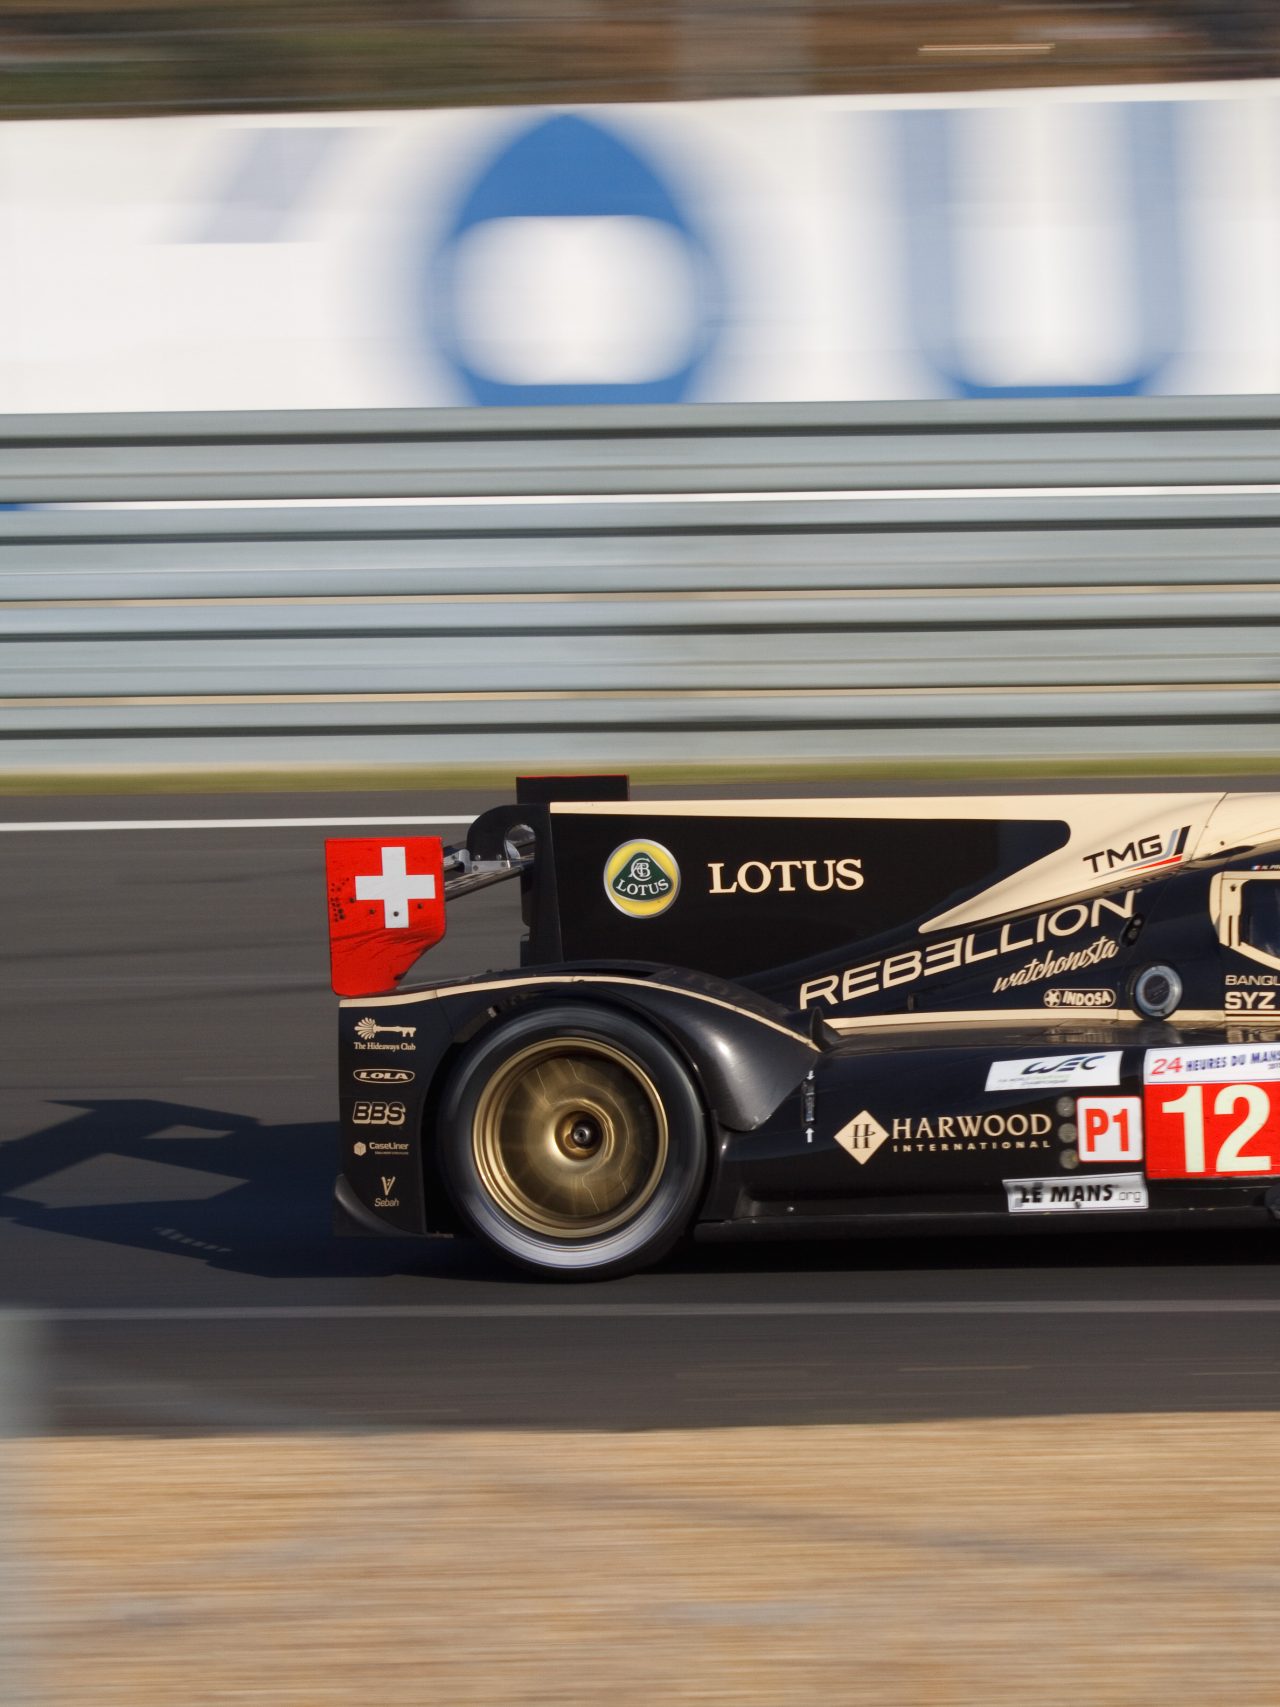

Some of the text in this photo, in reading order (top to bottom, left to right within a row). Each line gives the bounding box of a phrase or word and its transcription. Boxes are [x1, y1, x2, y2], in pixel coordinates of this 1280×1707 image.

[1083, 834, 1163, 873] TMG
[708, 859, 865, 894] LOTUS
[616, 878, 669, 897] LOTUS
[800, 889, 1135, 1010] REBELLION
[992, 934, 1120, 994] watchonista
[1062, 990, 1113, 1006] INDOSA
[1225, 991, 1276, 1010] SYZ
[353, 1041, 416, 1053] The Hideaways Club
[1150, 1057, 1183, 1075] 24
[1185, 1056, 1228, 1072] HEURES
[1231, 1054, 1247, 1067] DU
[359, 1071, 409, 1080] LOLA
[352, 1101, 406, 1126] BBS
[892, 1113, 1053, 1140] HARWOOD
[1084, 1108, 1130, 1153] P1
[1162, 1084, 1272, 1173] 12
[368, 1141, 410, 1150] CaseLiner
[893, 1140, 1051, 1153] INTERNATIONAL
[374, 1197, 400, 1207] Sebah
[1050, 1184, 1113, 1203] MANS
